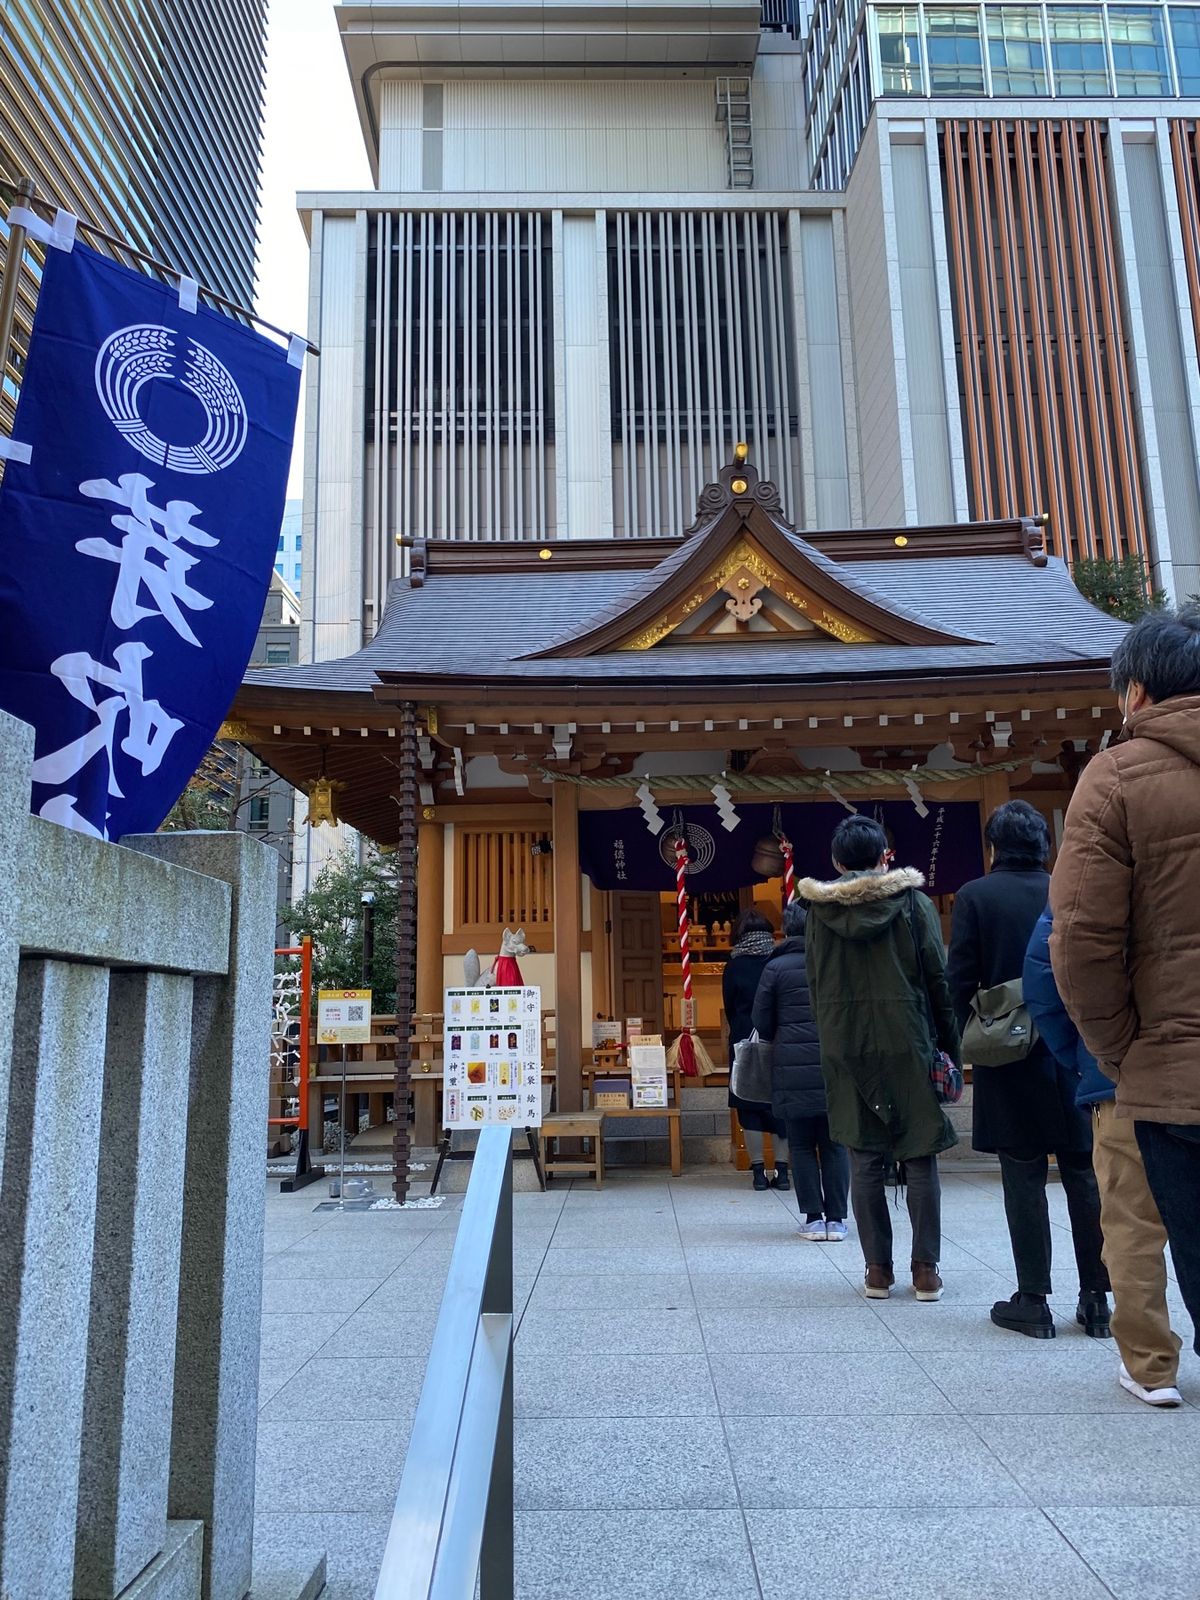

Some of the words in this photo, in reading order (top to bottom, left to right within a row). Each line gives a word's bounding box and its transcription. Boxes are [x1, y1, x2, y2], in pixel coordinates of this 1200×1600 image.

[613, 839, 628, 880] 福徳神社
[929, 807, 945, 887] 平成二十六年十月吉日
[527, 989, 535, 1012] 御守
[527, 1094, 536, 1118] 絵馬
